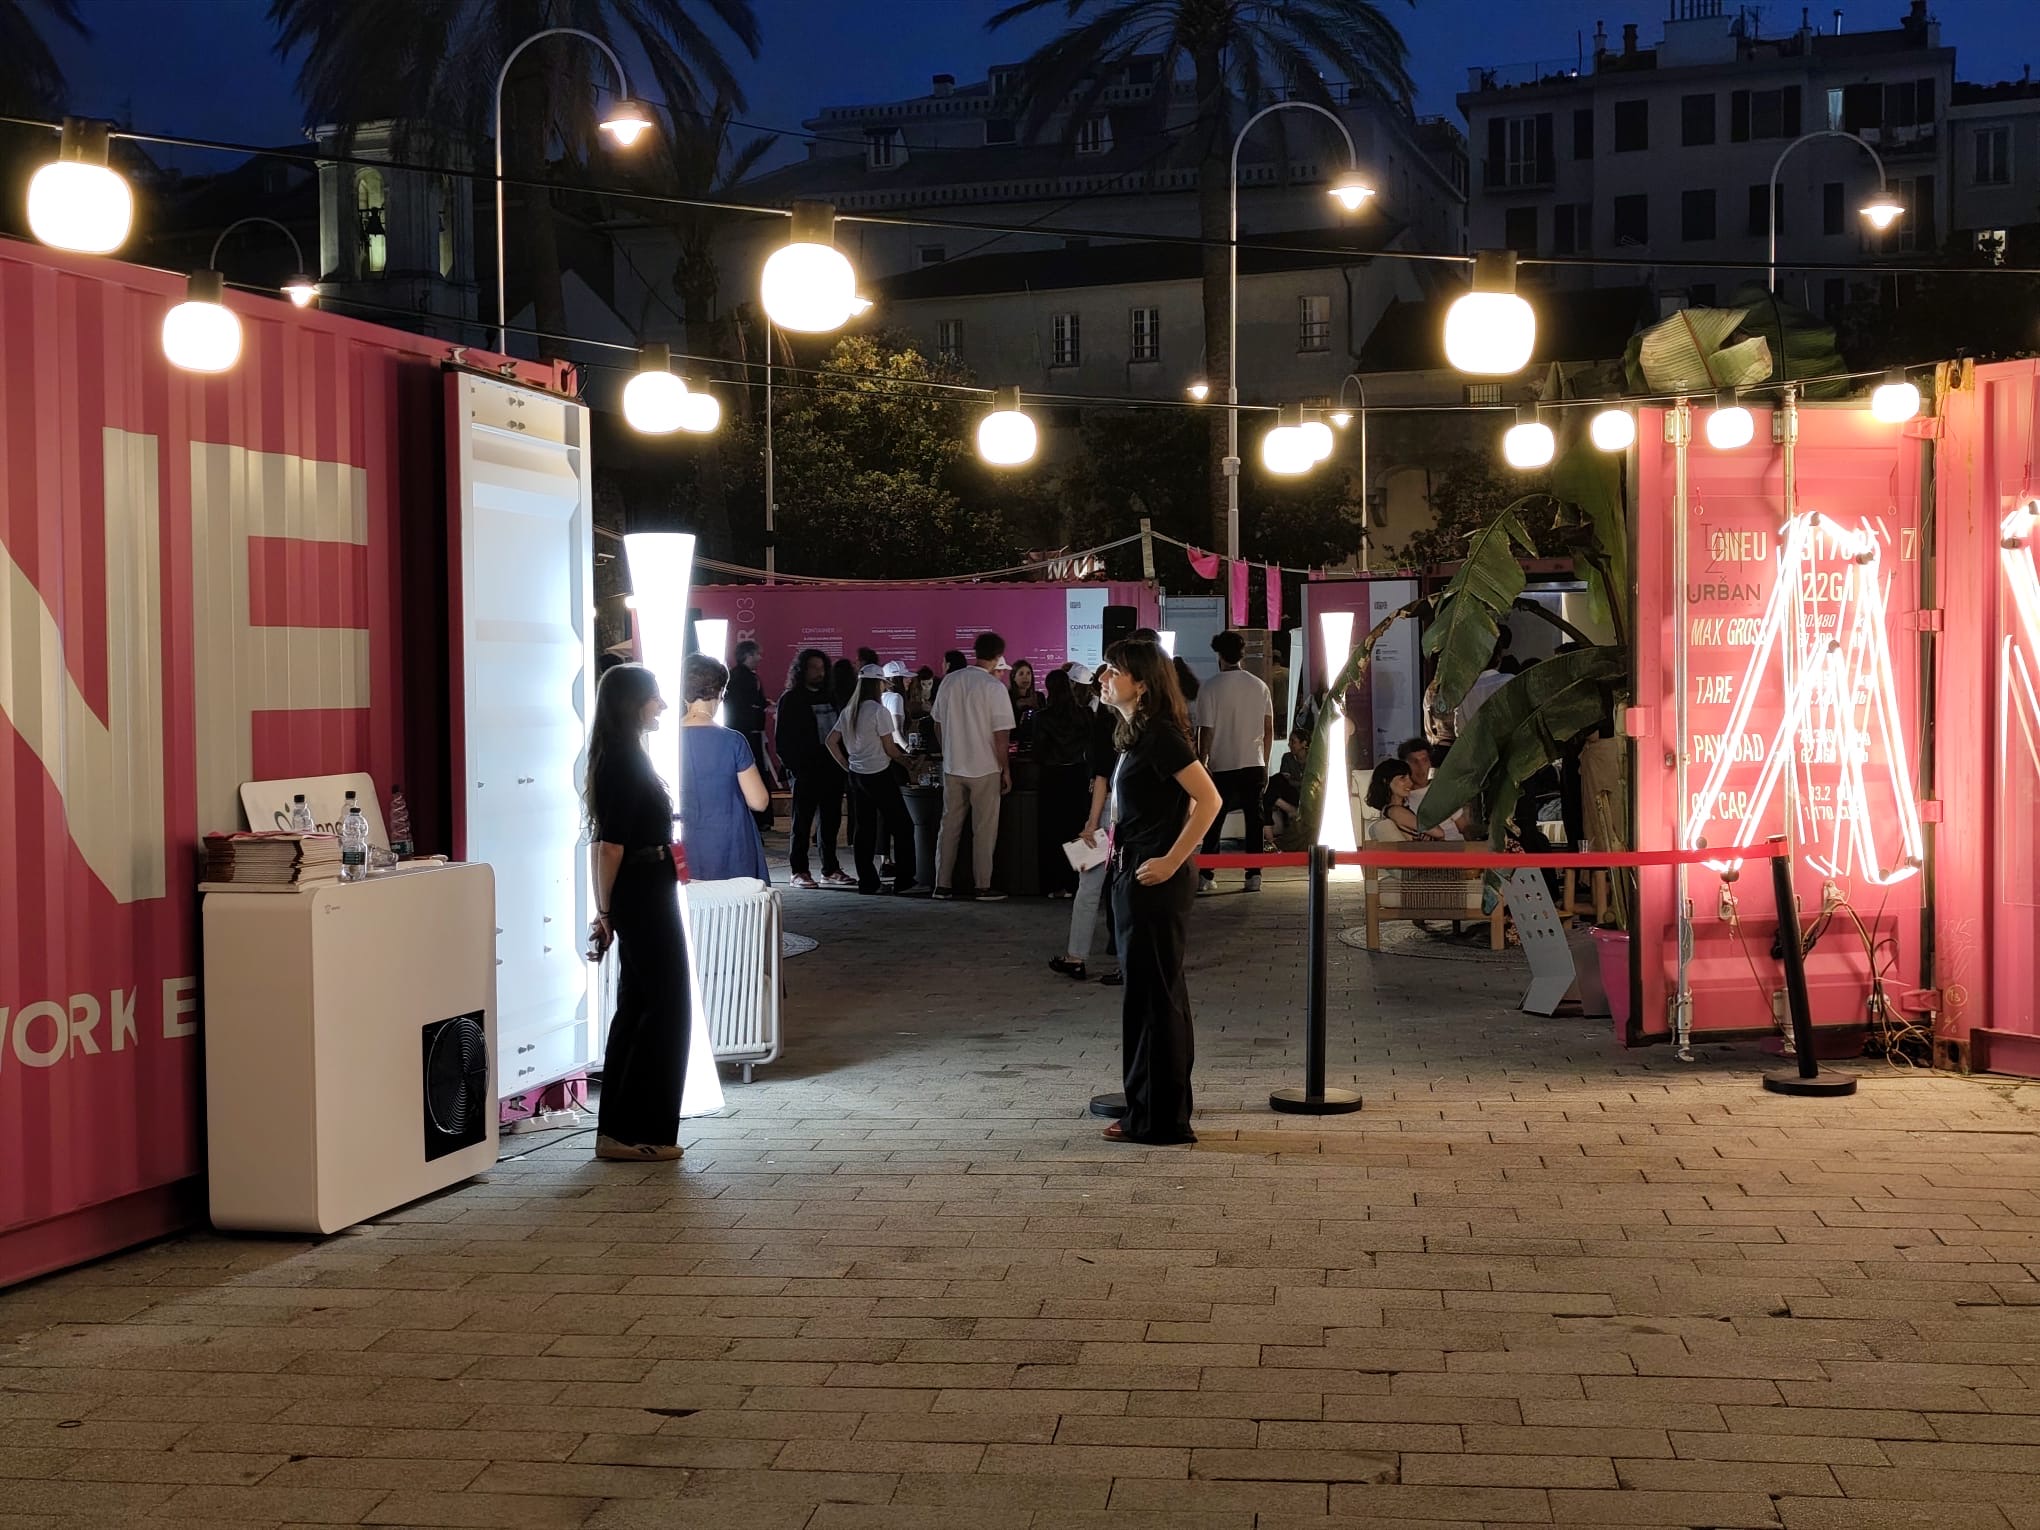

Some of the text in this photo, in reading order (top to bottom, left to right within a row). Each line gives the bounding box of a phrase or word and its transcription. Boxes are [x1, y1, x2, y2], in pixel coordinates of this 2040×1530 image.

[1902, 529, 1915, 560] 7
[1687, 583, 1761, 604] URBAN
[1691, 618, 1725, 646] MAX
[1695, 675, 1733, 704] TARE
[0, 984, 139, 1074] ORK
